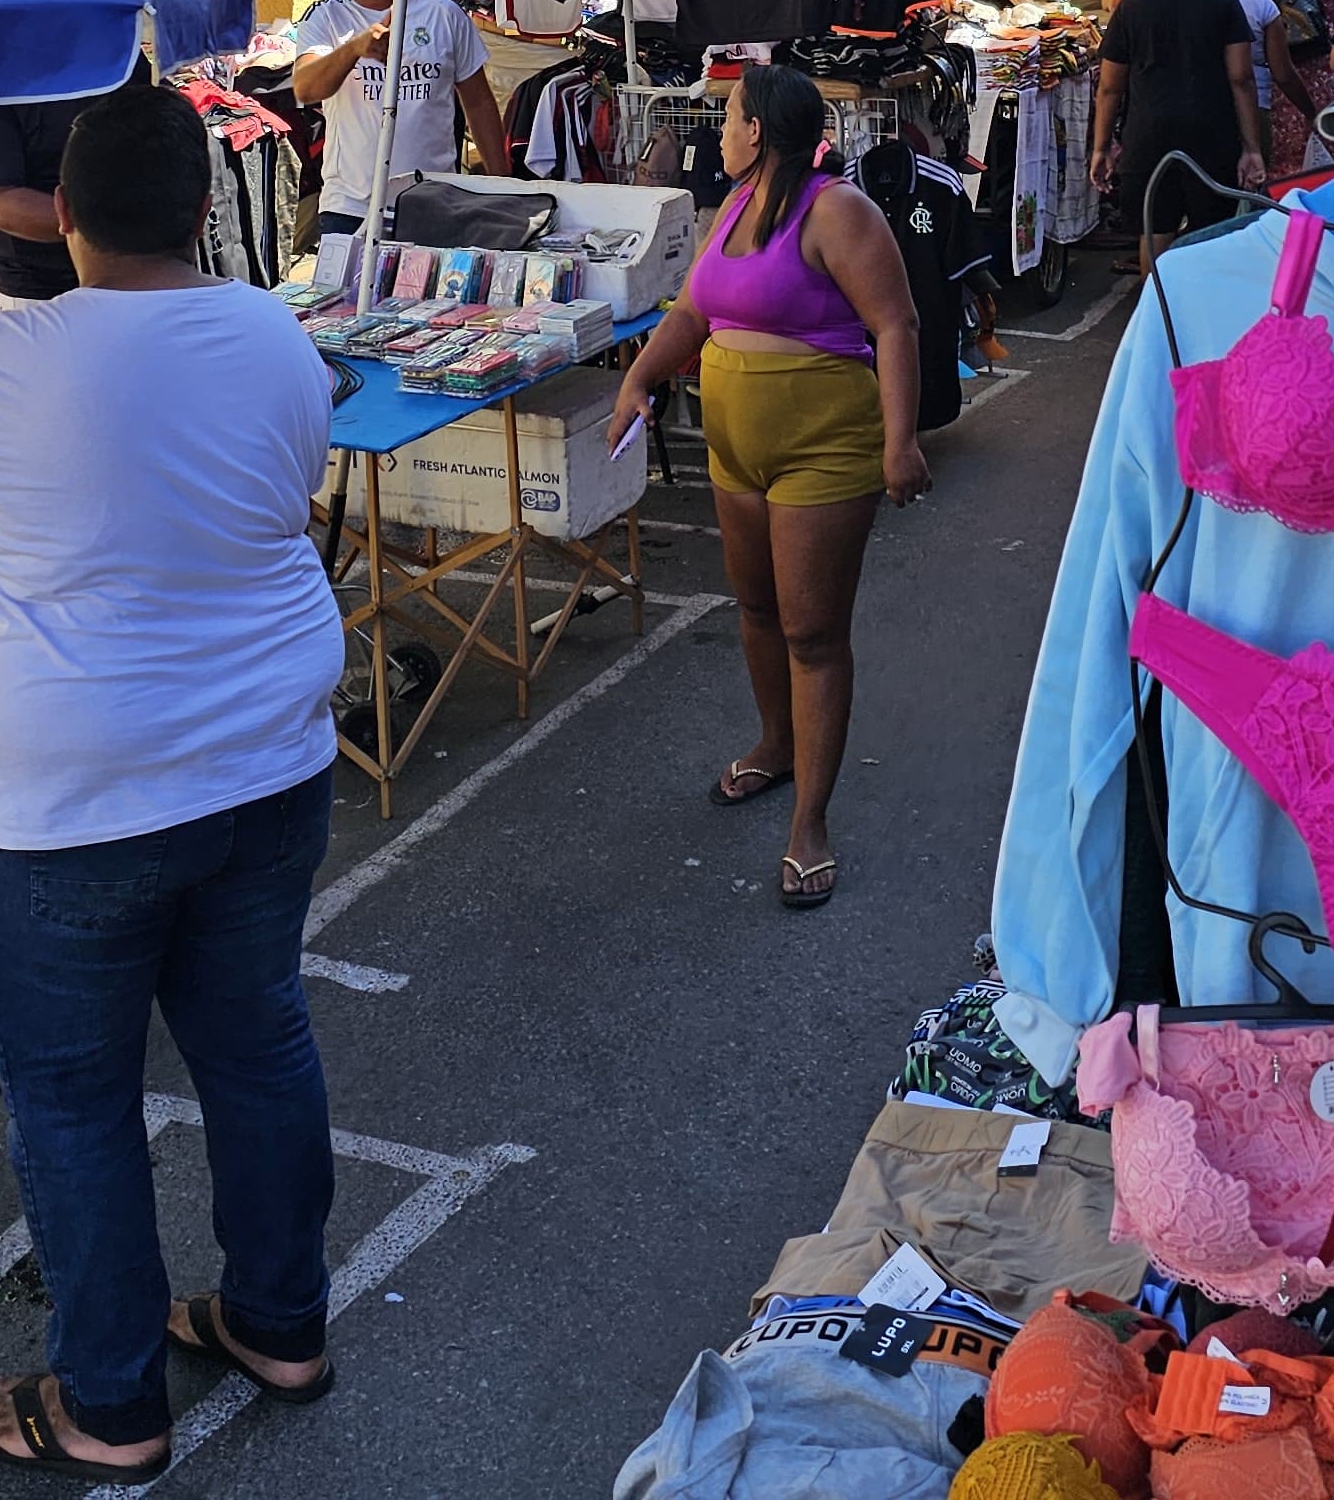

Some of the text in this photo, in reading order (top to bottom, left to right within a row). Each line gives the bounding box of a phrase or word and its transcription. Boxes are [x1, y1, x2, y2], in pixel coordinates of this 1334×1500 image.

[363, 82, 432, 101] FLY ETTER
[413, 459, 560, 485] FRESH ATLANTIC ALMON
[948, 1046, 983, 1074] UOMO
[730, 1317, 848, 1358] LUPO
[871, 1316, 907, 1358] LUPO
